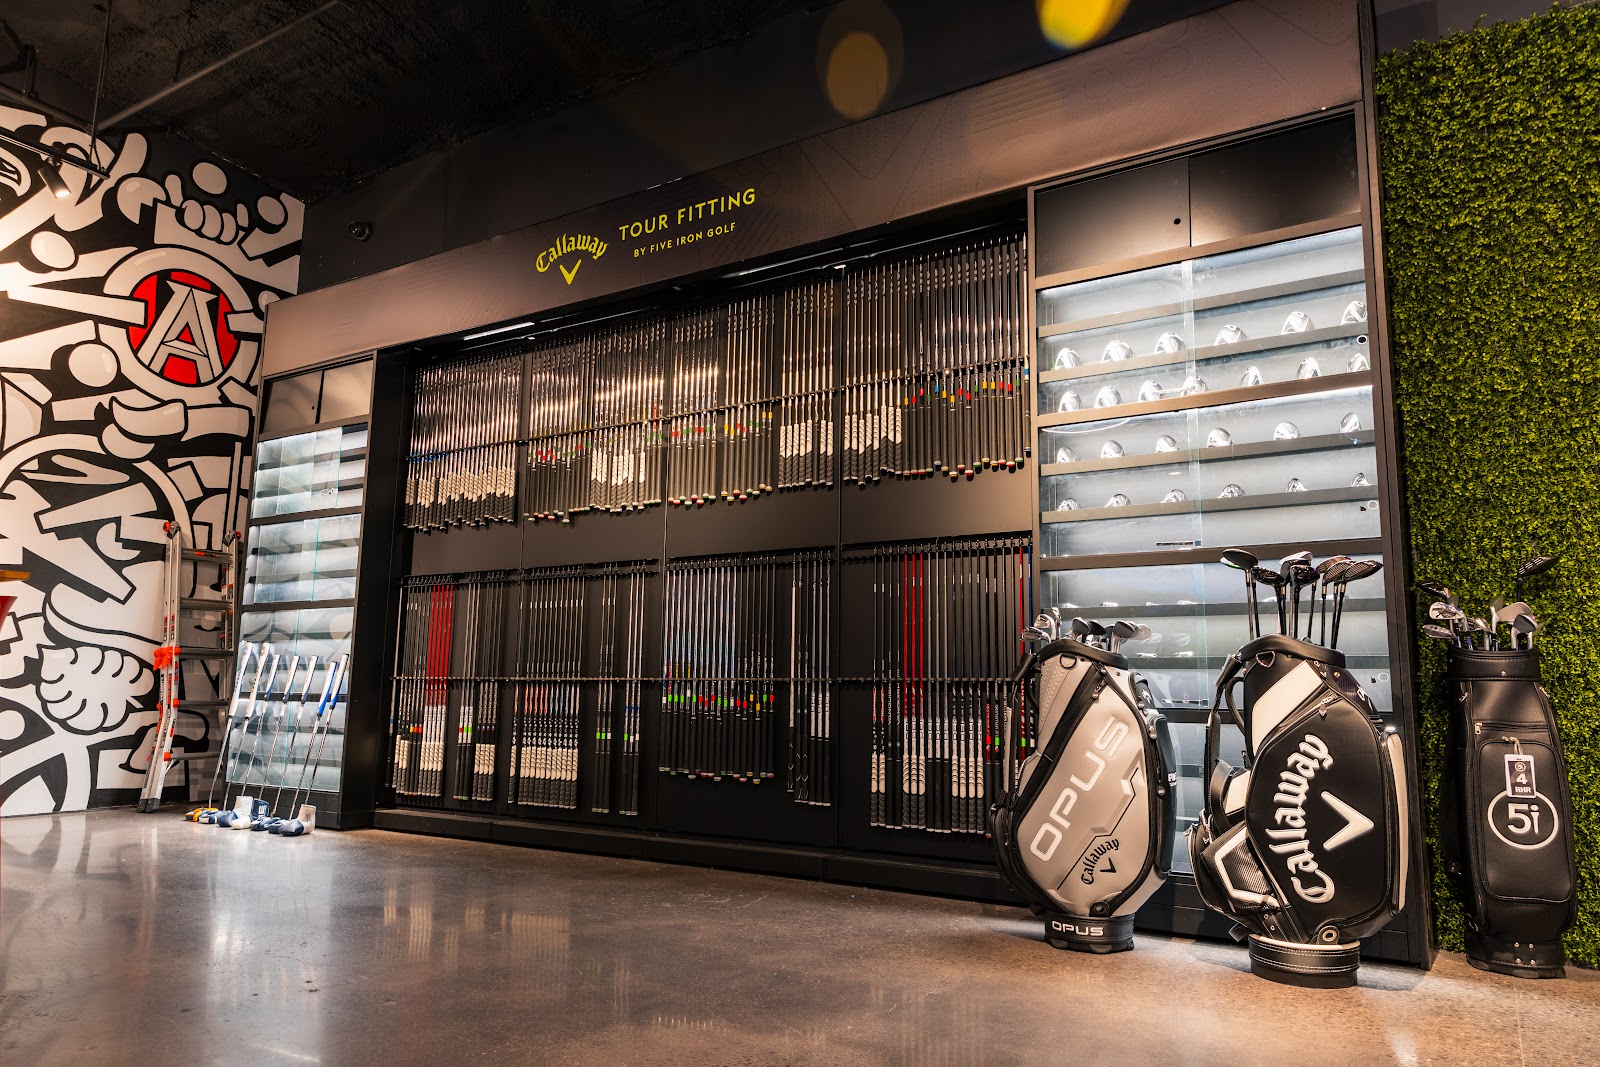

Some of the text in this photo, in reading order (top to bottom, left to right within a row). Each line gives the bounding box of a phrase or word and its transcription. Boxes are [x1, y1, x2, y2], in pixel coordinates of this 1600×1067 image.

[618, 188, 756, 241] TOUR FITTING
[535, 233, 609, 273] Callaway
[633, 222, 736, 258] BY FIVE IRON GOLF
[136, 280, 224, 384] A
[1029, 715, 1130, 863] OPUS
[1516, 773, 1528, 785] 4
[1267, 732, 1334, 905] Callaway
[1507, 803, 1540, 834] 5i
[1080, 838, 1120, 885] Callaway
[1051, 920, 1104, 937] OPUS
